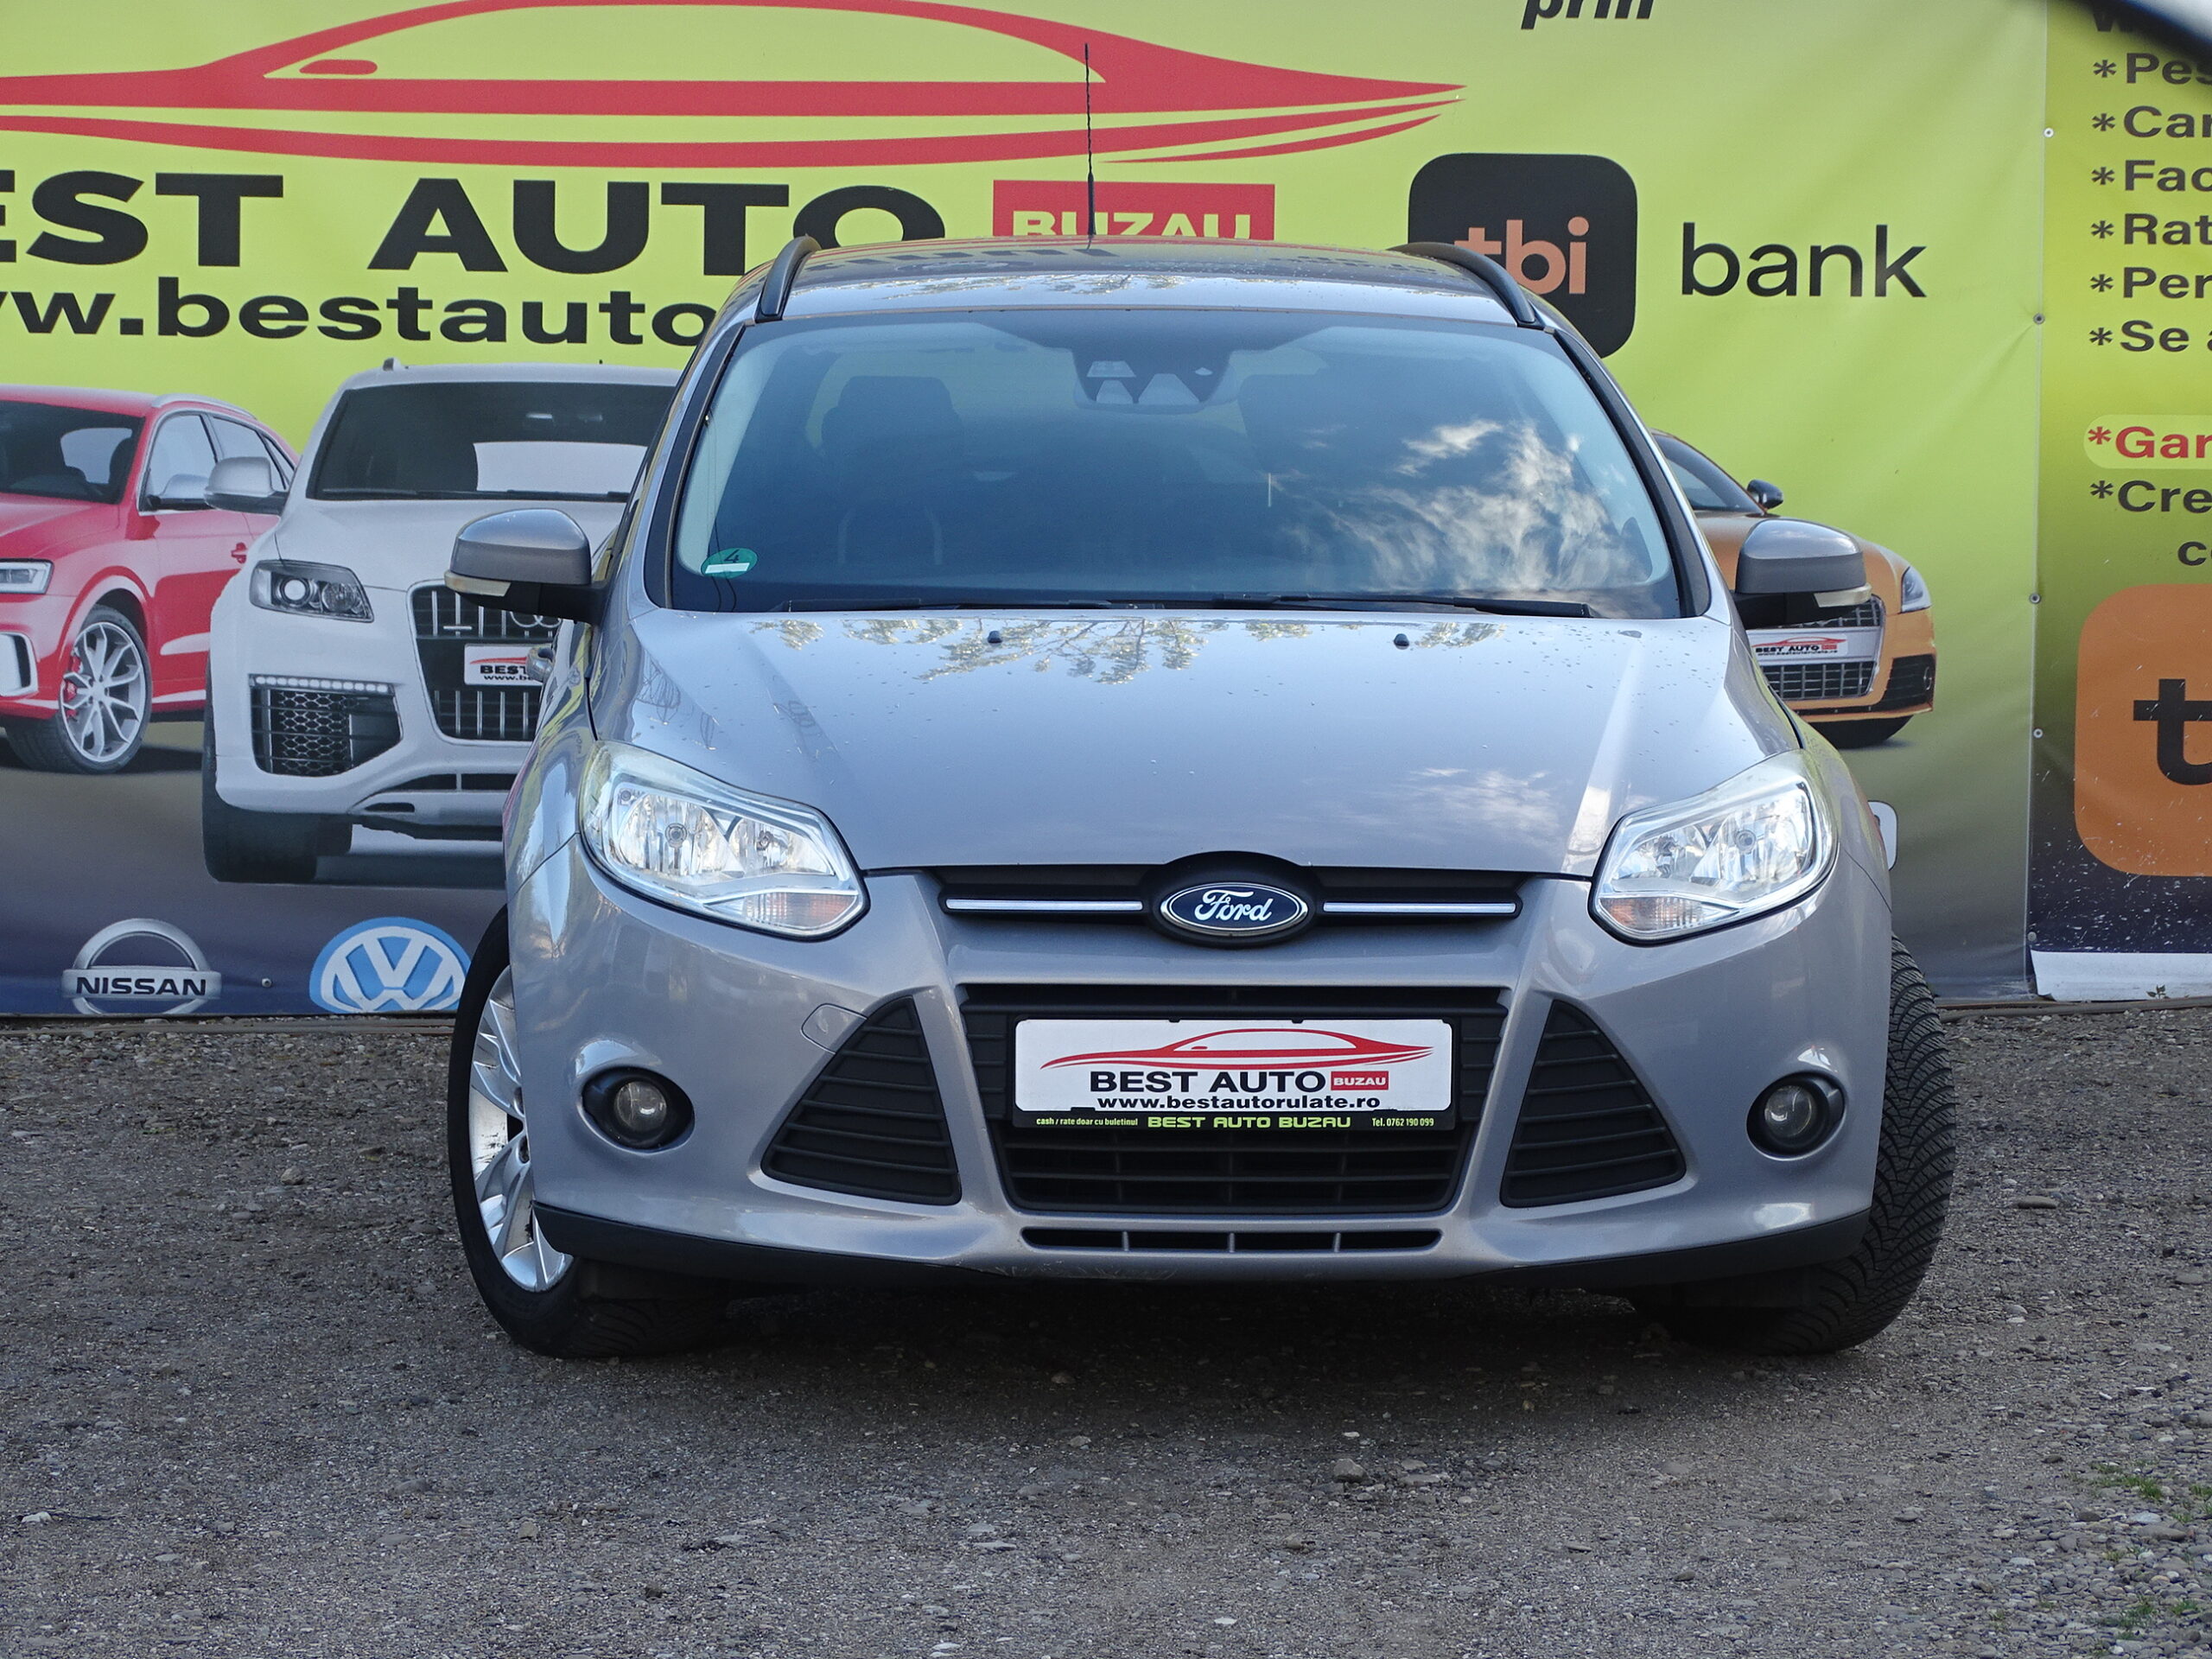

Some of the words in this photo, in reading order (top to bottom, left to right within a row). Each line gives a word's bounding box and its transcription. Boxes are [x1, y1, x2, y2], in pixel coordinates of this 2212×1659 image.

[0, 169, 283, 268] ST
[367, 178, 946, 276] AUTO
[1681, 222, 1927, 297] bank
[1194, 889, 1274, 921] Ford
[76, 976, 207, 996] NISSAN
[1090, 1071, 1198, 1092] BEST
[1209, 1071, 1326, 1093] AUTO
[1333, 1077, 1388, 1087] BUZAU
[1097, 1095, 1381, 1109] www.bestautorulate.ro
[1077, 1117, 1093, 1126] doar
[1104, 1117, 1138, 1126] buletinul
[1147, 1116, 1206, 1128] BEST
[1213, 1116, 1271, 1128] AUTO
[1278, 1116, 1351, 1128] BUZAU
[1371, 1117, 1386, 1126] Tel.
[1386, 1118, 1404, 1127] 0762
[1406, 1118, 1419, 1127] 190
[1420, 1118, 1434, 1127] 099
